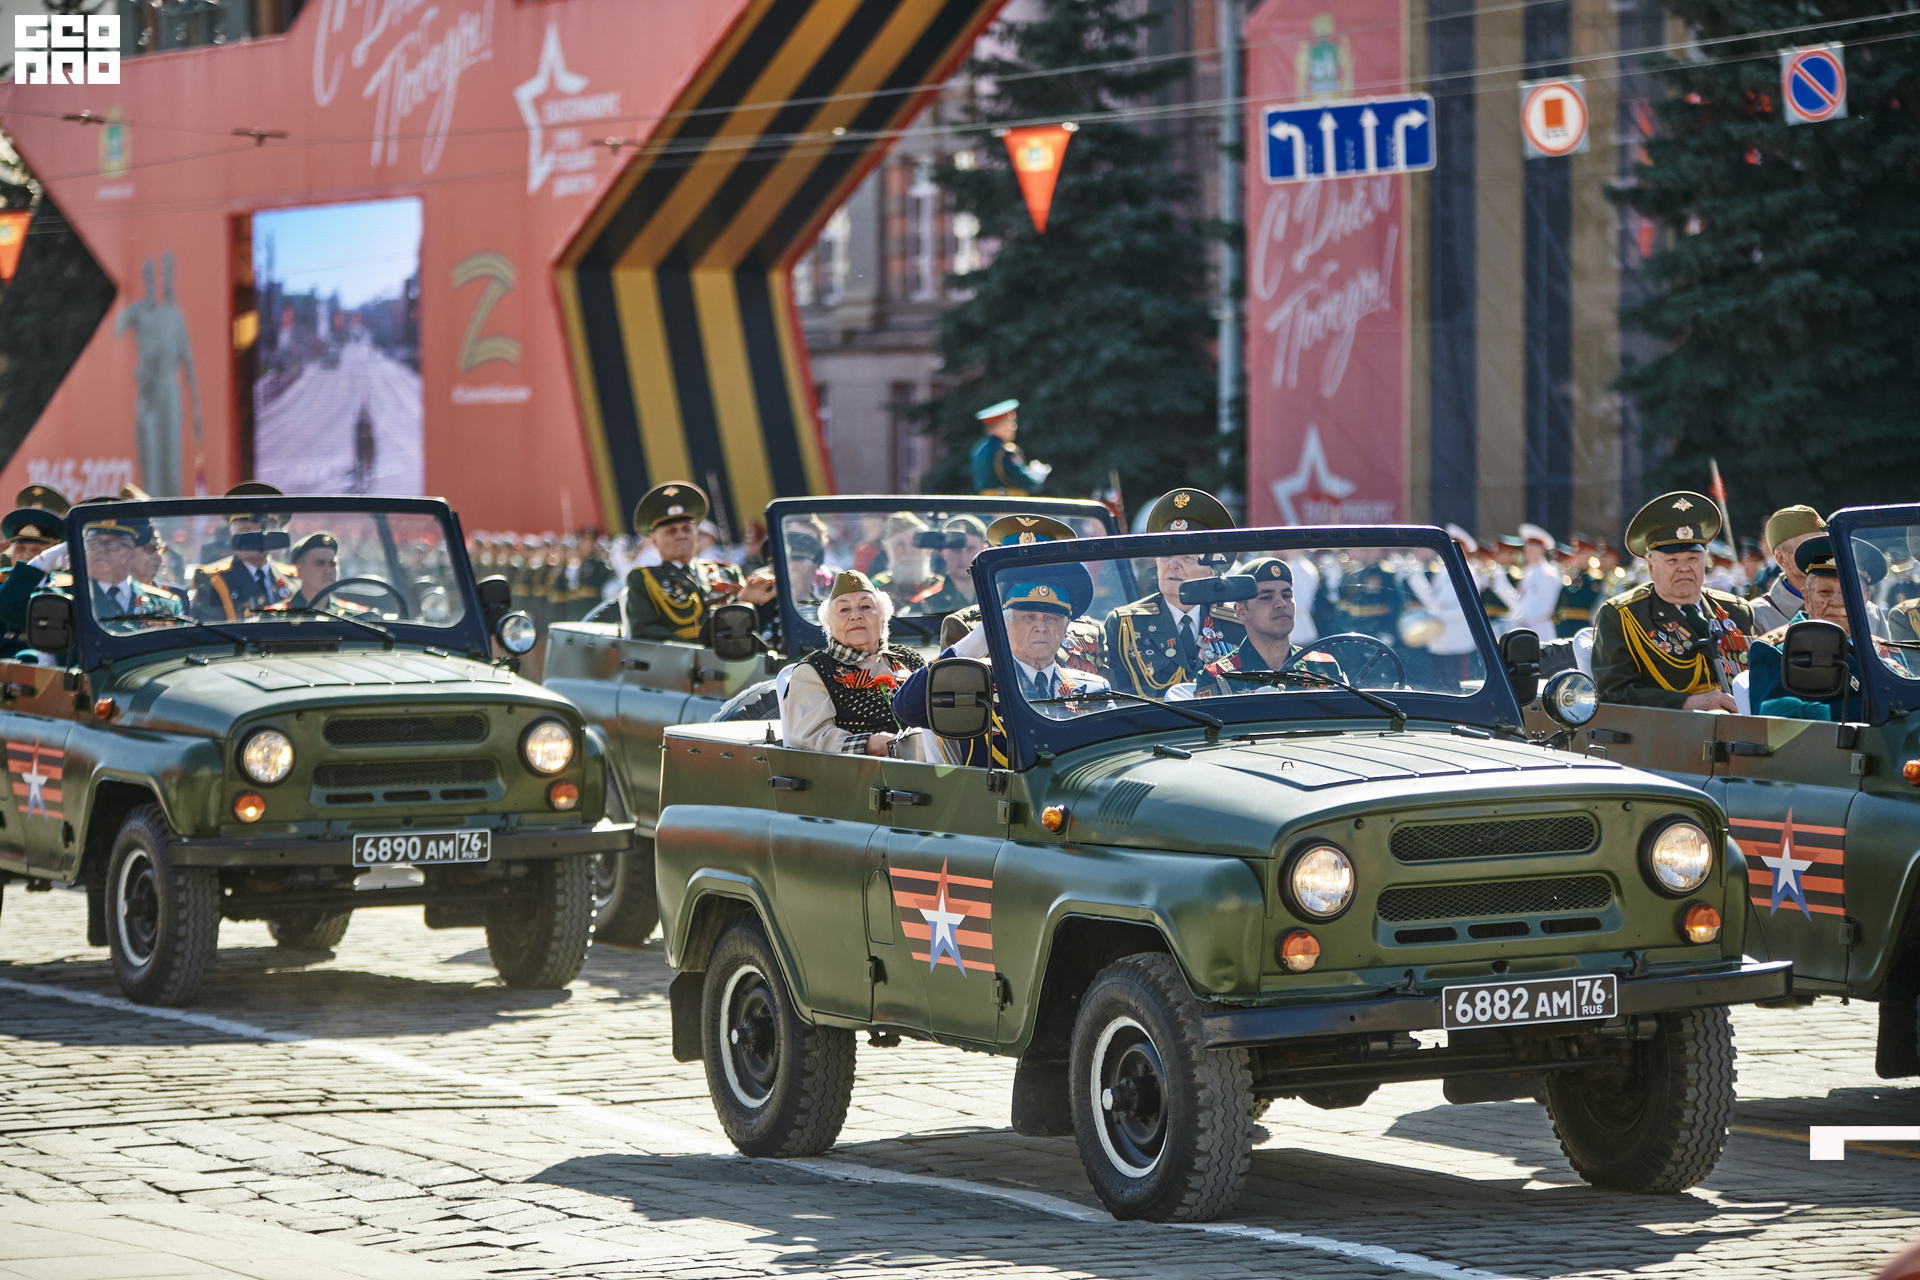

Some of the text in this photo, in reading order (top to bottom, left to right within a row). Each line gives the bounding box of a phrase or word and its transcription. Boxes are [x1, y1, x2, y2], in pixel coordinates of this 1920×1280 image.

[362, 836, 421, 862] 6890
[459, 833, 482, 852] 76
[461, 851, 480, 859] RUS
[1455, 987, 1530, 1024] 6882
[1577, 979, 1606, 1006] 76
[1582, 1005, 1603, 1016] RUS
